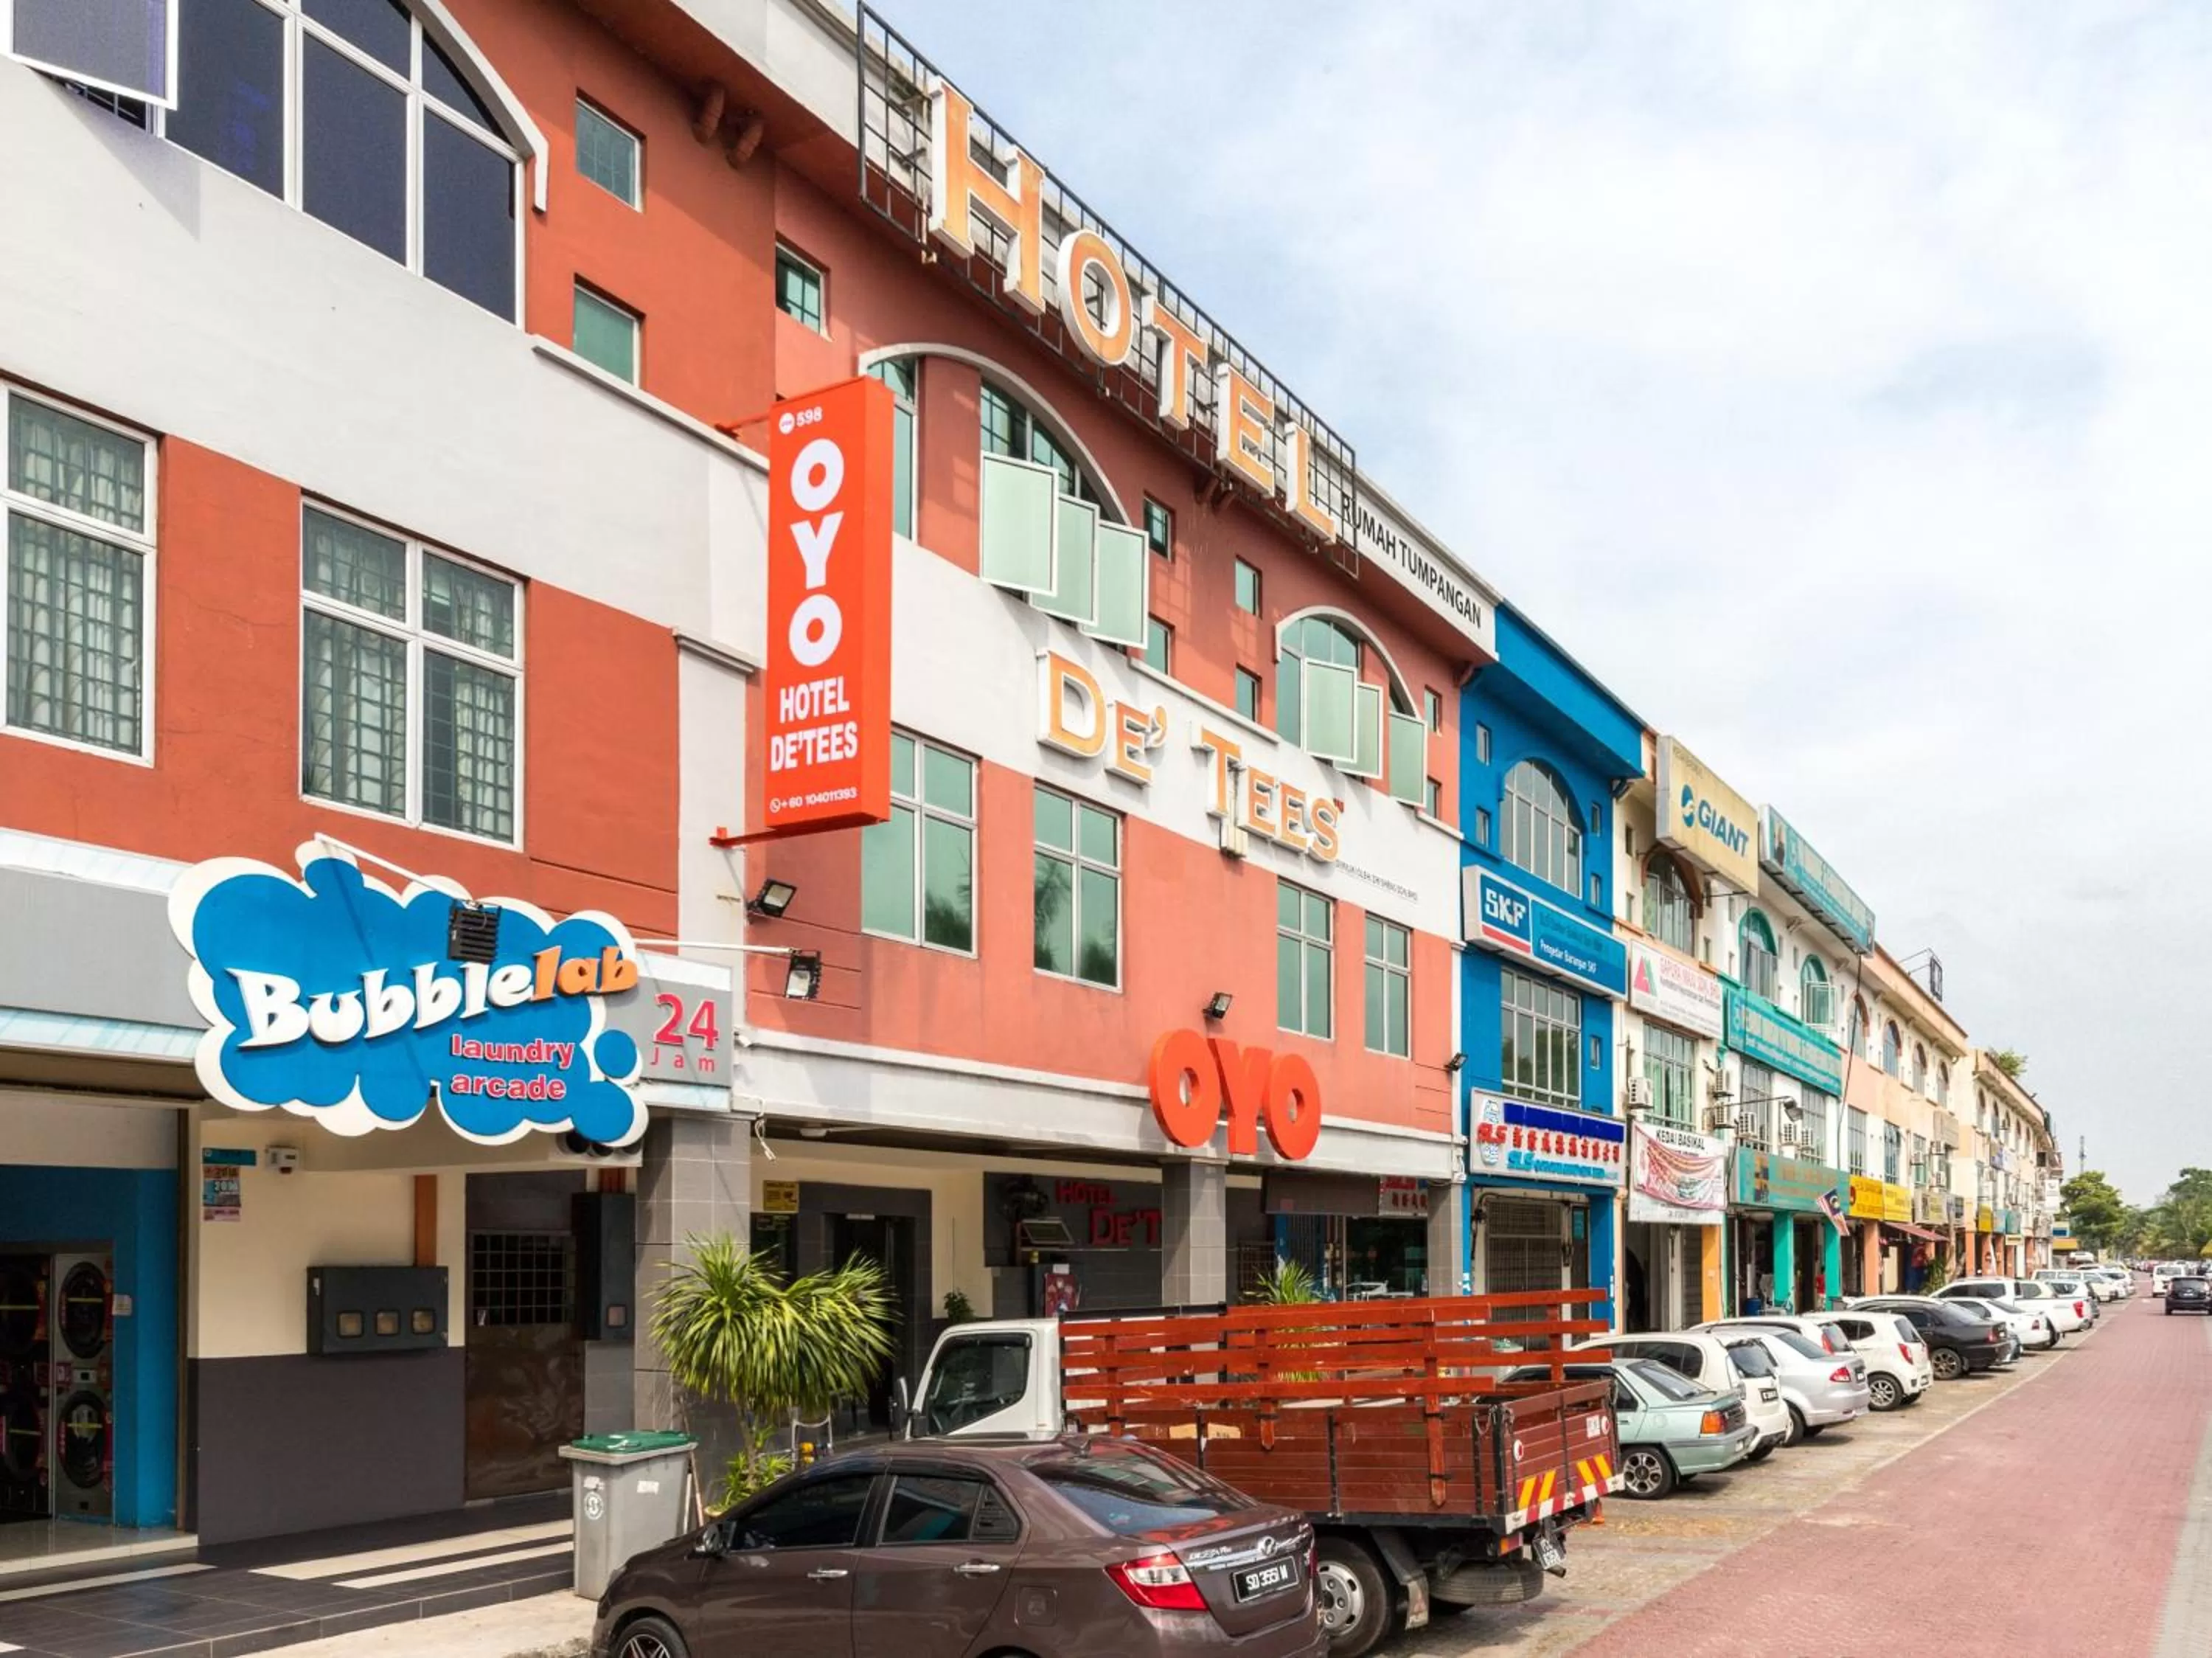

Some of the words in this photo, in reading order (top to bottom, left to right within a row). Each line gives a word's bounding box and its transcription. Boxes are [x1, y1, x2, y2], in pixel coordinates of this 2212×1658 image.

[929, 76, 1336, 546] HOTEL
[796, 406, 823, 427] 598
[787, 438, 844, 667] OYO
[1342, 492, 1397, 560] RUMAH
[1399, 539, 1481, 628] TUMPANGAN
[779, 675, 850, 724] HOTEL
[770, 721, 858, 772] DE'TEES
[1698, 799, 1750, 858] GIANT
[1485, 887, 1526, 928] SKF
[226, 946, 639, 1050] Bubblelab
[653, 993, 720, 1050] 24
[450, 1034, 575, 1069] laundry
[450, 1072, 567, 1100] arcade
[1149, 1029, 1321, 1160] OYO
[1656, 1128, 1677, 1144] KEDAI
[1677, 1134, 1705, 1150] BASIKAL
[1055, 1179, 1119, 1205] HOTEL
